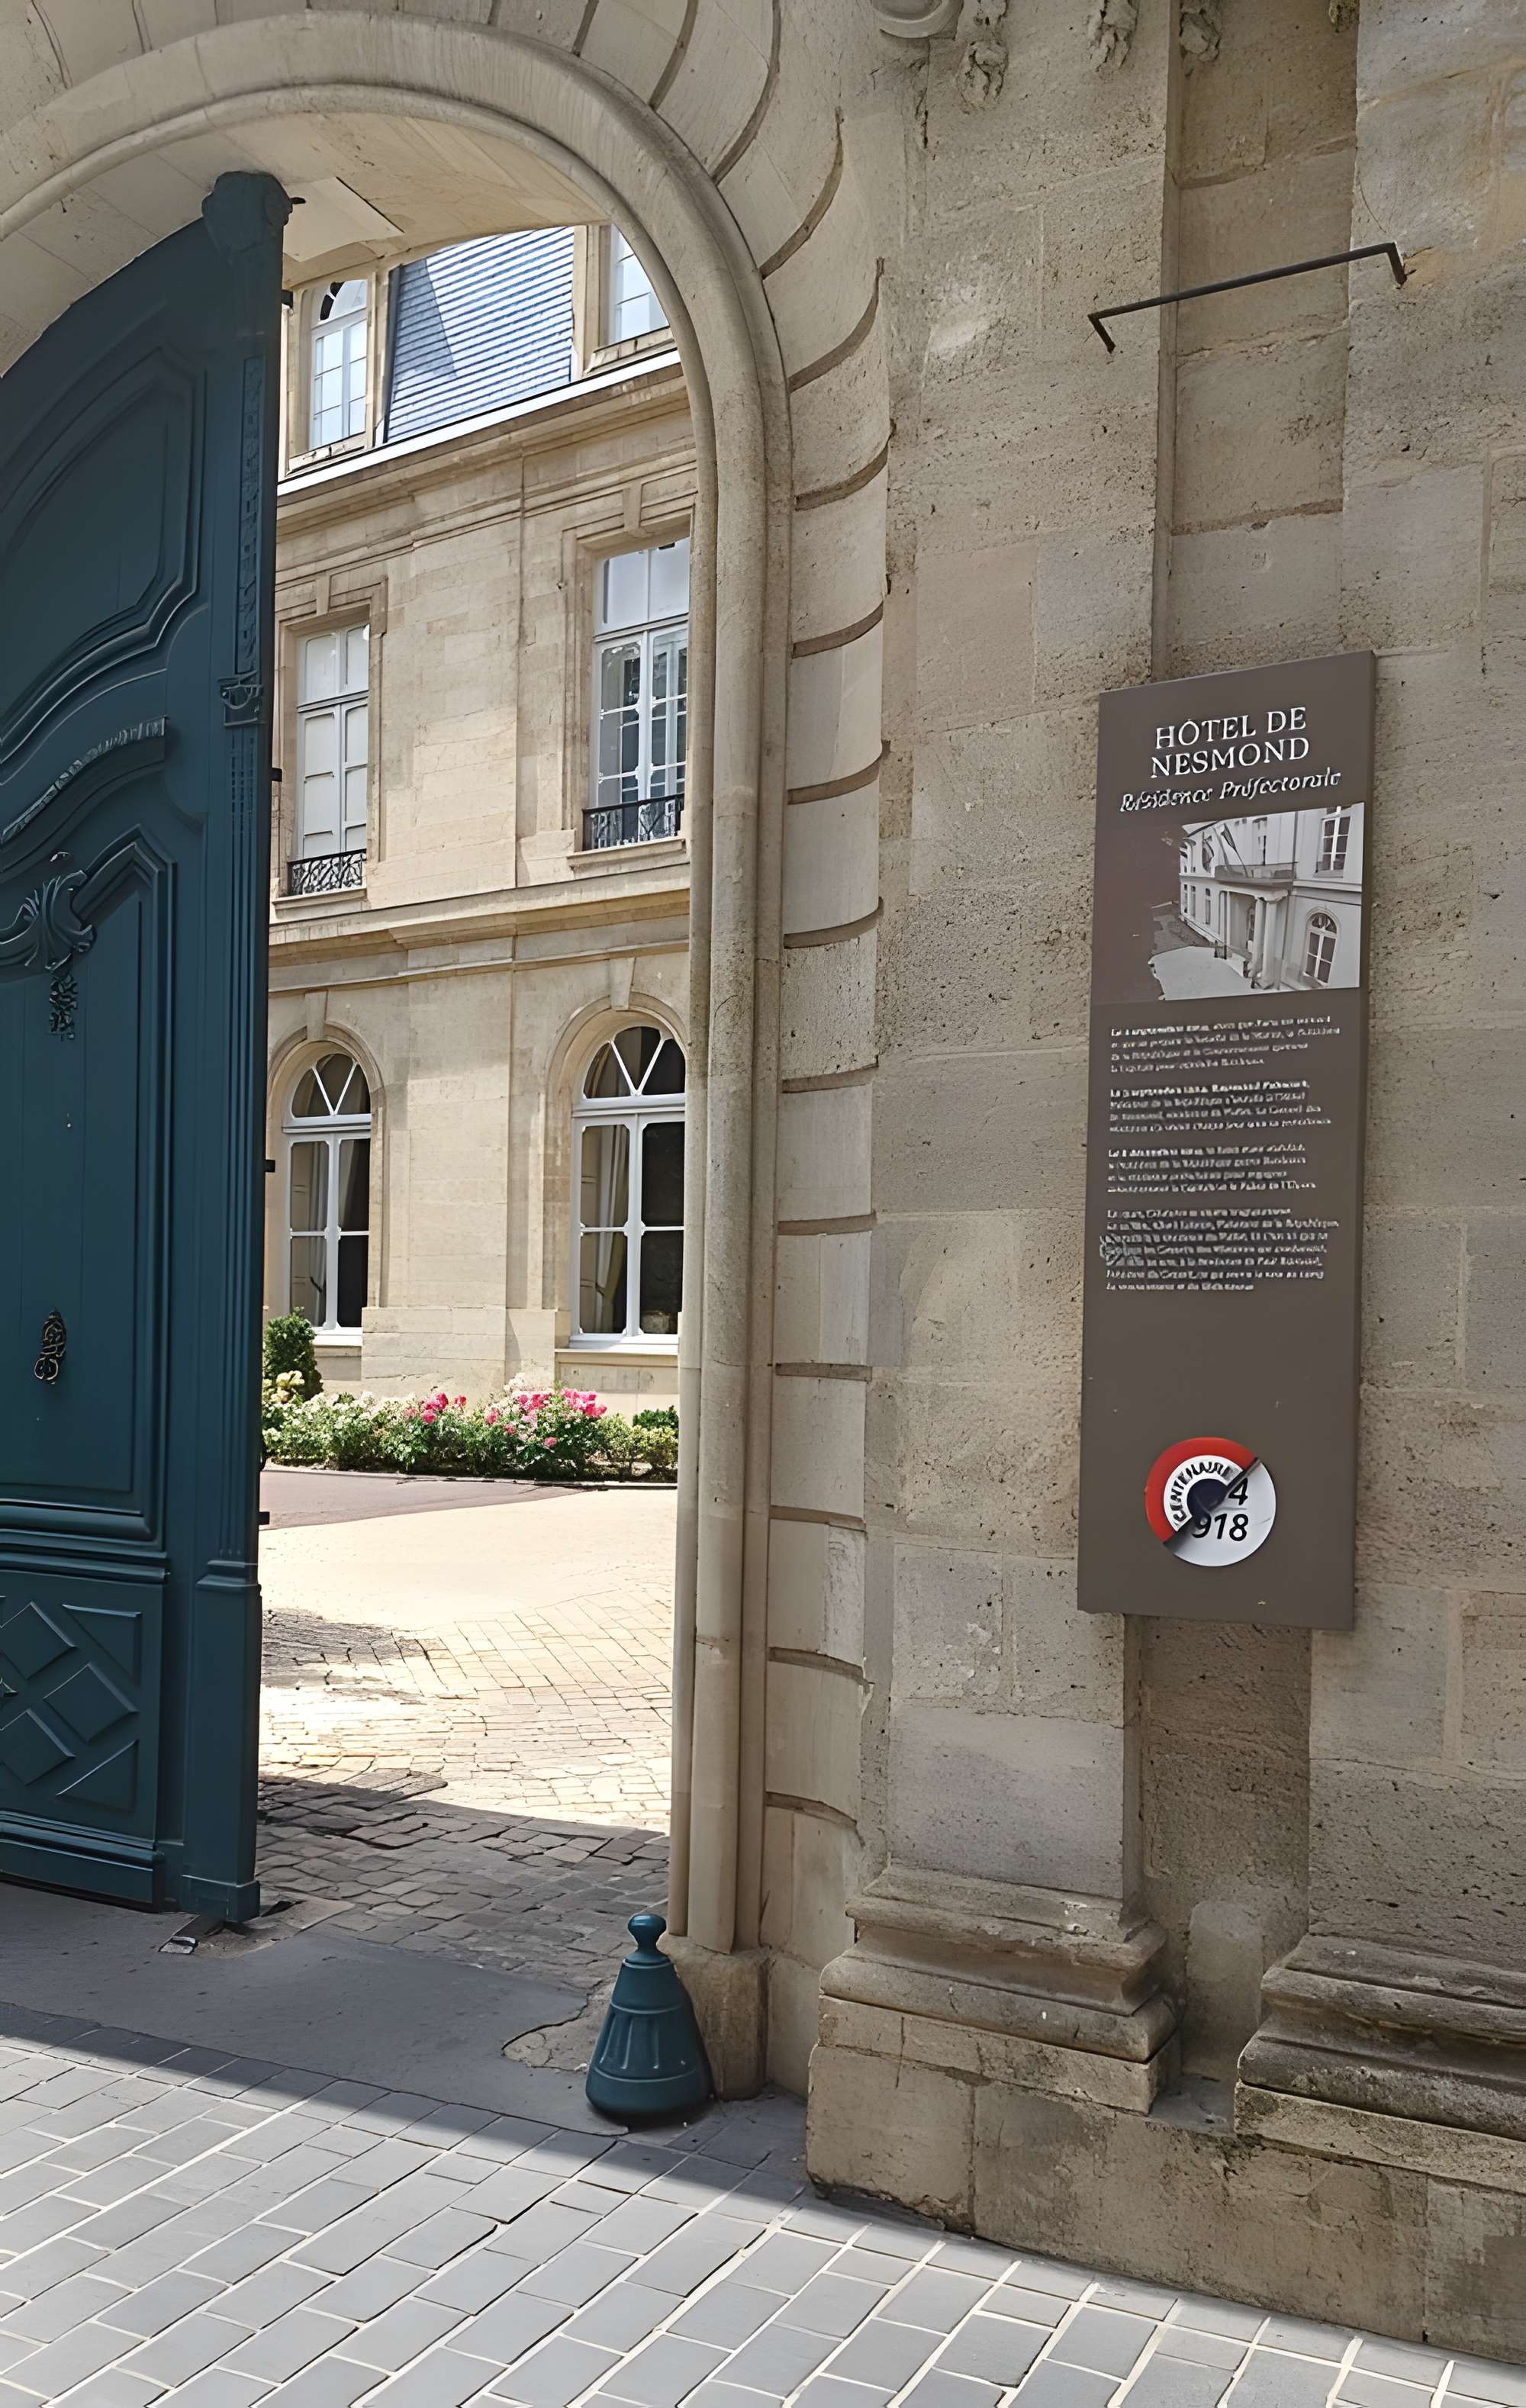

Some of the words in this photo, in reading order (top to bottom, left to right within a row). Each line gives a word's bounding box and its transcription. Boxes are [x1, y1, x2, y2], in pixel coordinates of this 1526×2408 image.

[1155, 714, 1257, 749] HÔTEL
[1266, 707, 1307, 734] DE
[1150, 737, 1310, 778] NESMOND
